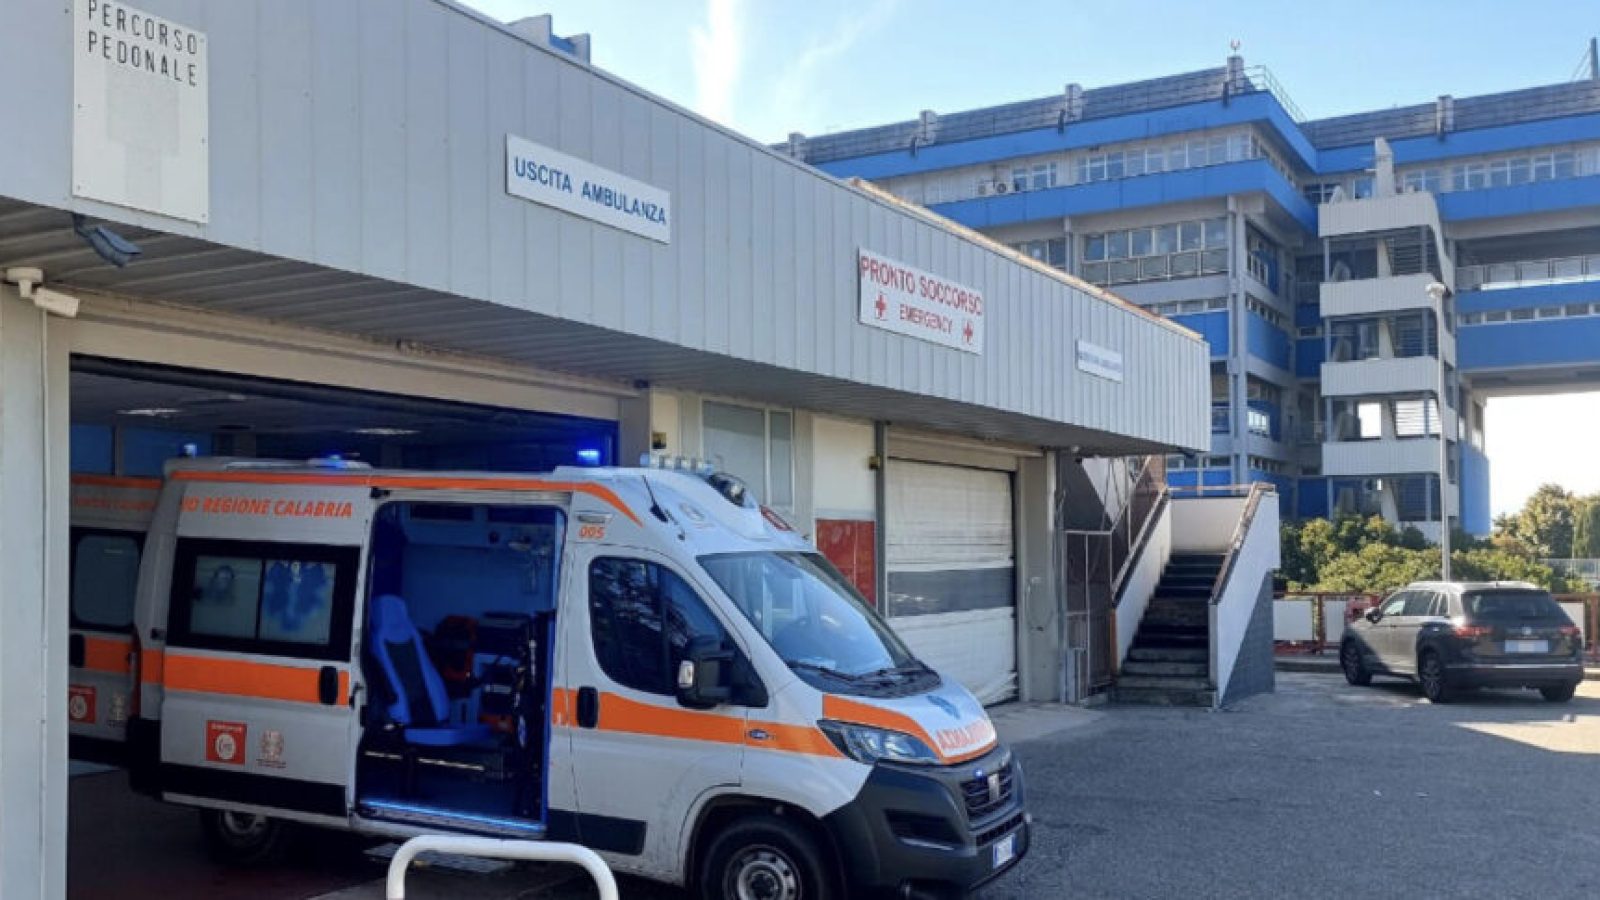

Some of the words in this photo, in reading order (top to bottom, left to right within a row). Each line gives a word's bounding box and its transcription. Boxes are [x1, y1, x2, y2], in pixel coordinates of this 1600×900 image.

[88, 0, 197, 55] PERCORSO
[88, 30, 197, 87] PEDONALE
[514, 156, 573, 194] USCITA
[581, 179, 667, 225] AMBULANZA
[860, 255, 916, 295] PRONTO
[203, 496, 270, 516] REGIONE
[273, 501, 353, 518] CALABRIA
